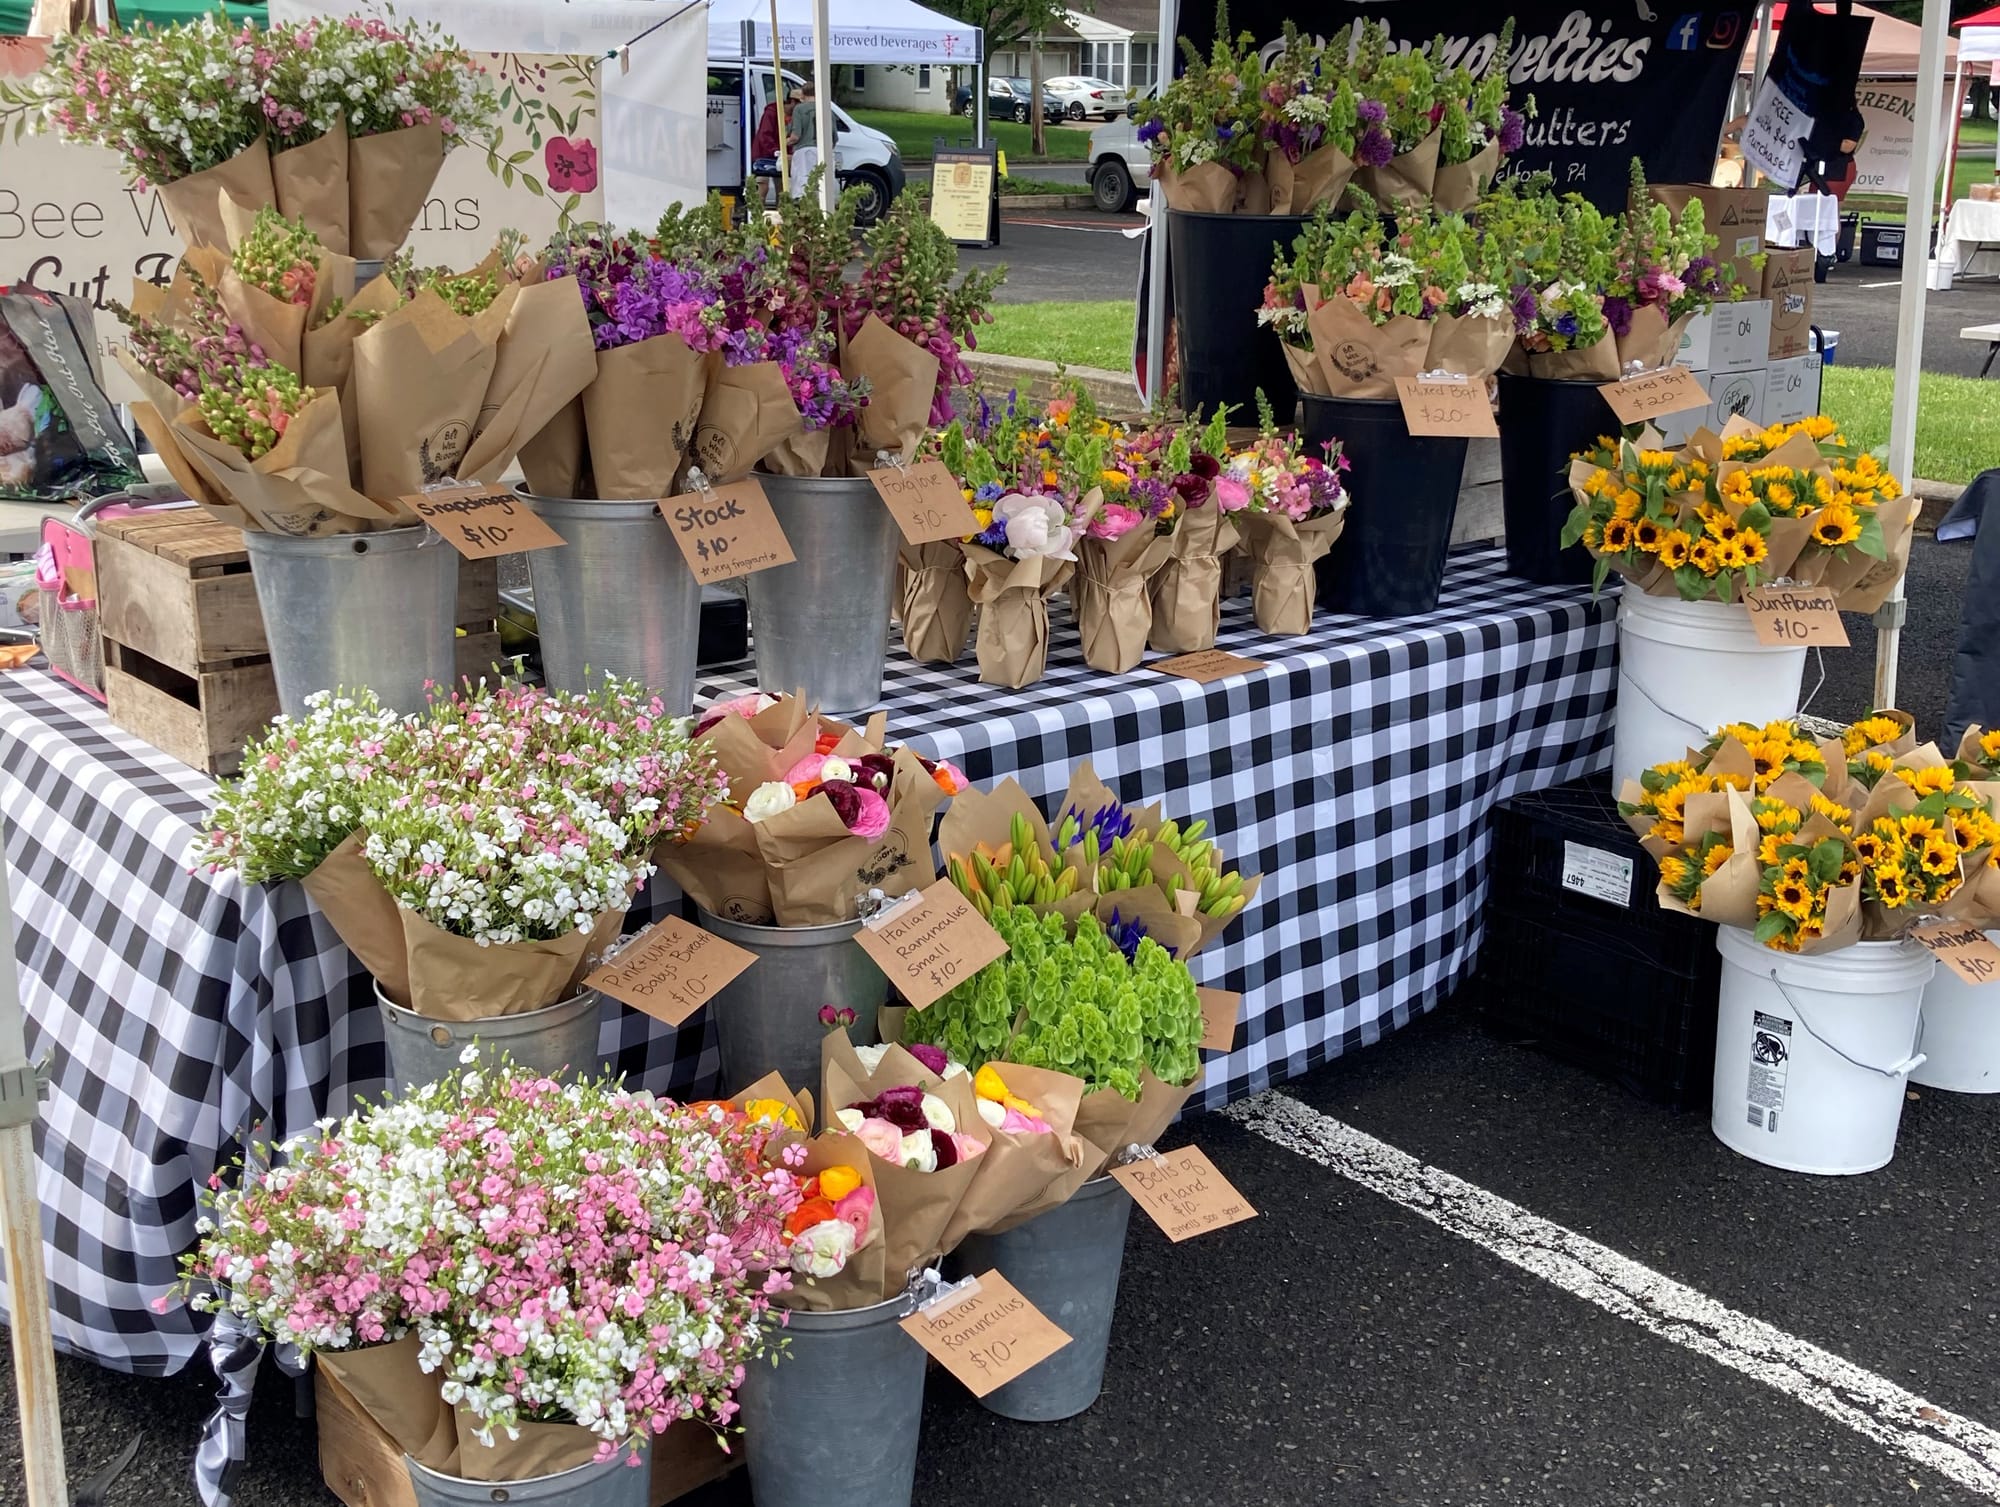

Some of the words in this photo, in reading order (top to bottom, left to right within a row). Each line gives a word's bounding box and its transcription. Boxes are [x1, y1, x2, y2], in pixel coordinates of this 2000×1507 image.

[881, 34, 938, 52] beverages
[1771, 97, 1794, 126] FREE
[1756, 115, 1772, 135] with
[1774, 127, 1796, 151] $40
[1748, 129, 1793, 173] Purchase!
[1567, 162, 1587, 183] PA
[0, 189, 104, 239] Bee
[1406, 384, 1444, 397] Mixed
[1614, 380, 1658, 397] Mixed
[880, 473, 942, 504] Foxglove
[416, 493, 522, 518] Snapdragon
[711, 563, 733, 576] very
[732, 551, 769, 571] fragrant
[1746, 591, 1836, 614] Sunflowers
[1566, 873, 1585, 888] 4467
[878, 908, 934, 946] Italian
[895, 904, 969, 961] Ranunculus
[669, 931, 716, 963] Breath
[907, 943, 951, 978] Small
[1130, 1165, 1180, 1190] Bells
[1180, 1158, 1207, 1176] of
[1144, 1178, 1209, 1209] Ireland
[1170, 1219, 1201, 1237] smells
[921, 1297, 984, 1337] Italian
[941, 1296, 1026, 1351] Ranunculus
